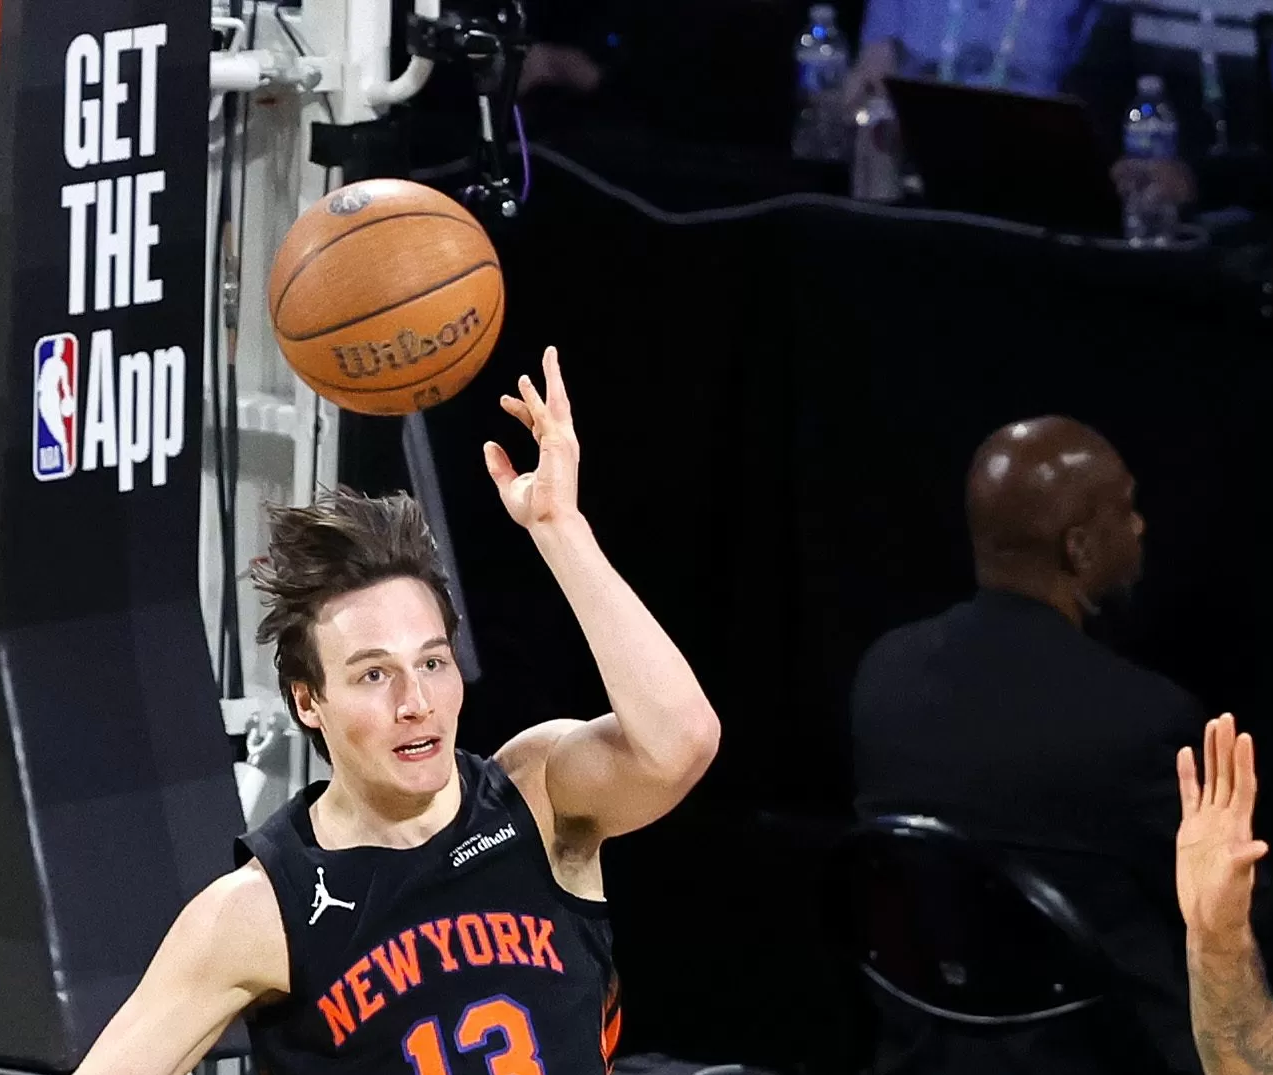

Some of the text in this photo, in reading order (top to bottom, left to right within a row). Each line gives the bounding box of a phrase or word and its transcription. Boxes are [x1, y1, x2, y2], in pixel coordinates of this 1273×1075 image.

[64, 23, 167, 169] GET
[61, 170, 165, 315] THE
[82, 329, 186, 492] App
[331, 307, 480, 379] Wilson
[453, 845, 479, 867] abu
[477, 823, 516, 851] dhabi
